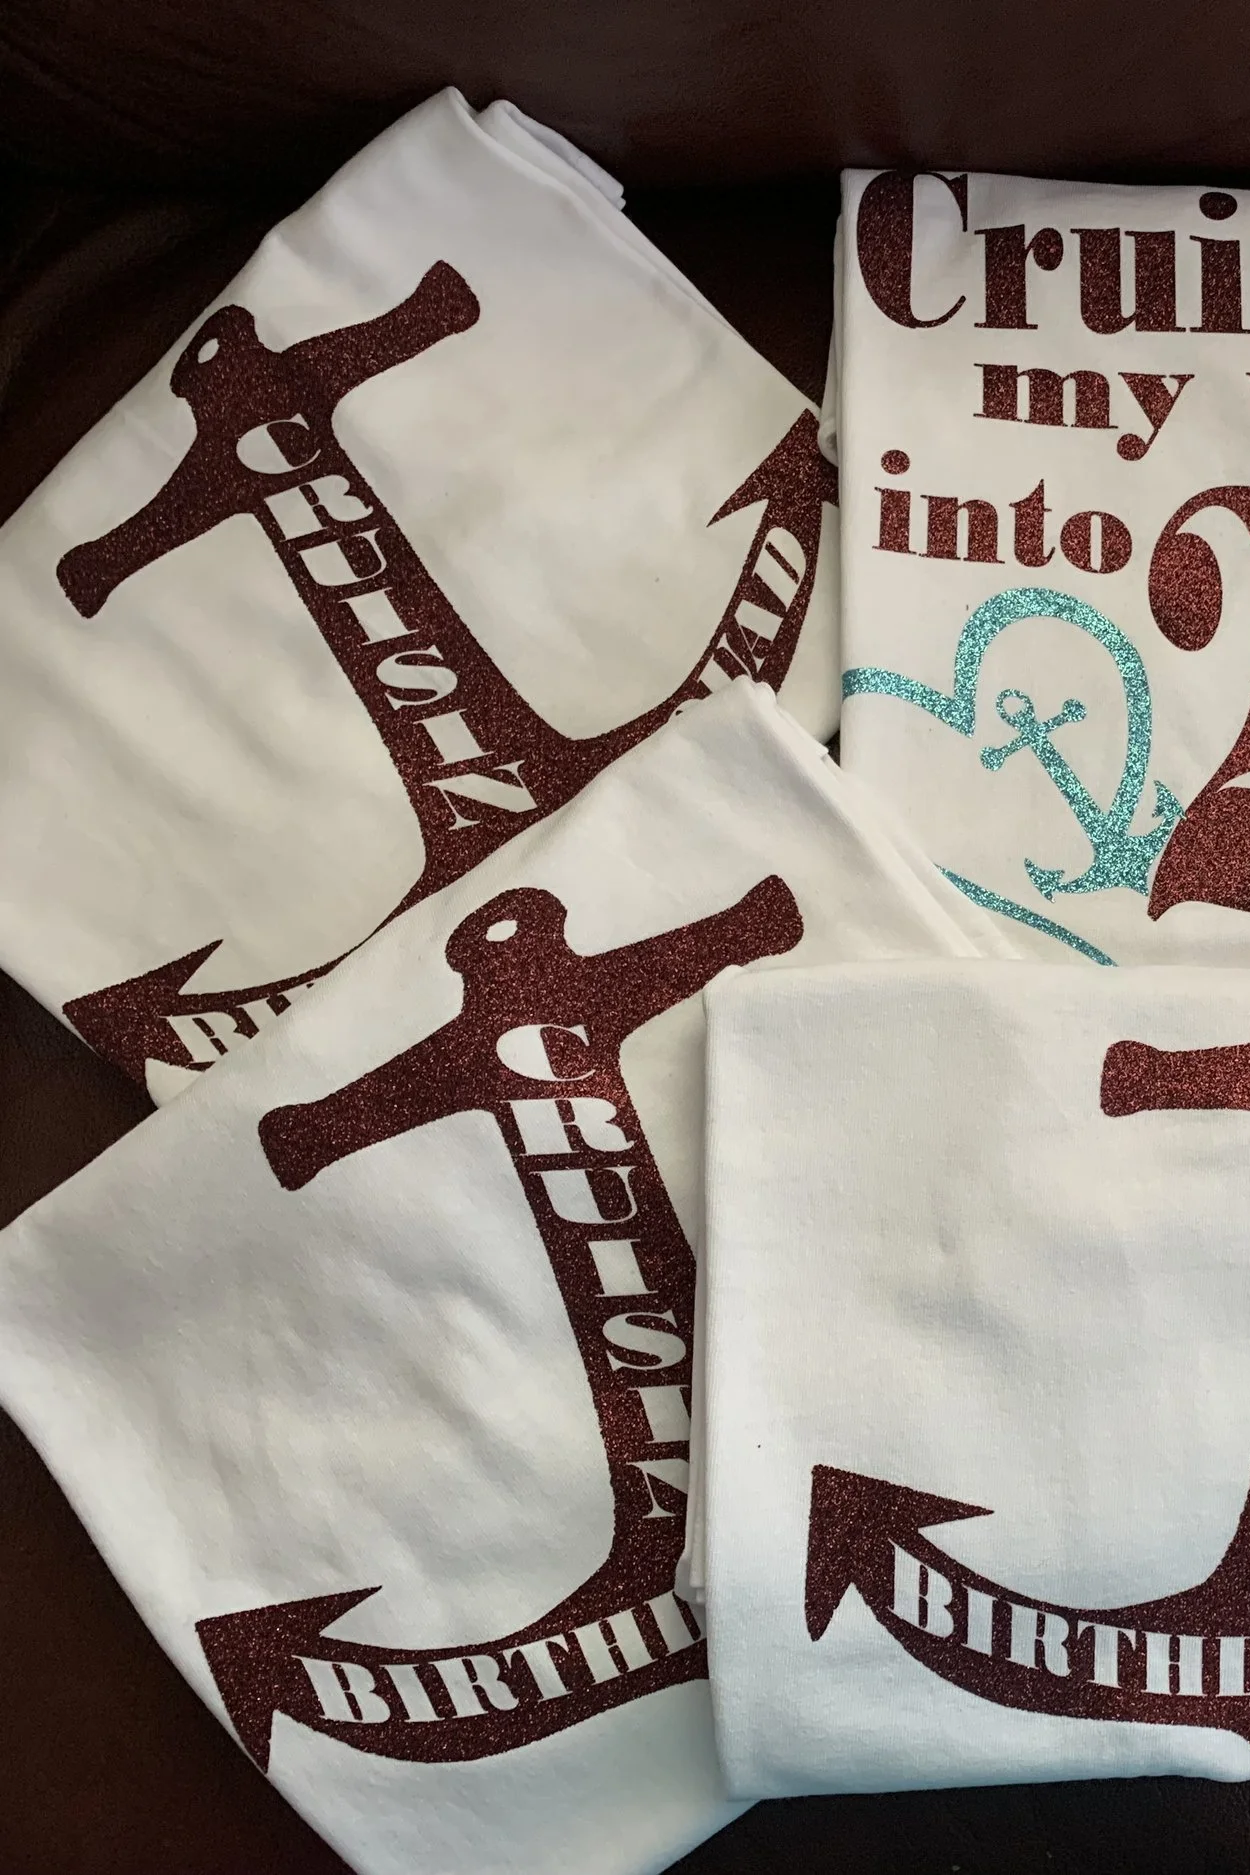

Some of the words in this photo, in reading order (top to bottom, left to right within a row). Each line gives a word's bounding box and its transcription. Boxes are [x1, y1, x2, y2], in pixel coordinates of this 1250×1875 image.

[973, 362, 1195, 461] my
[872, 449, 1133, 574] into
[237, 413, 538, 830] CRUISIN
